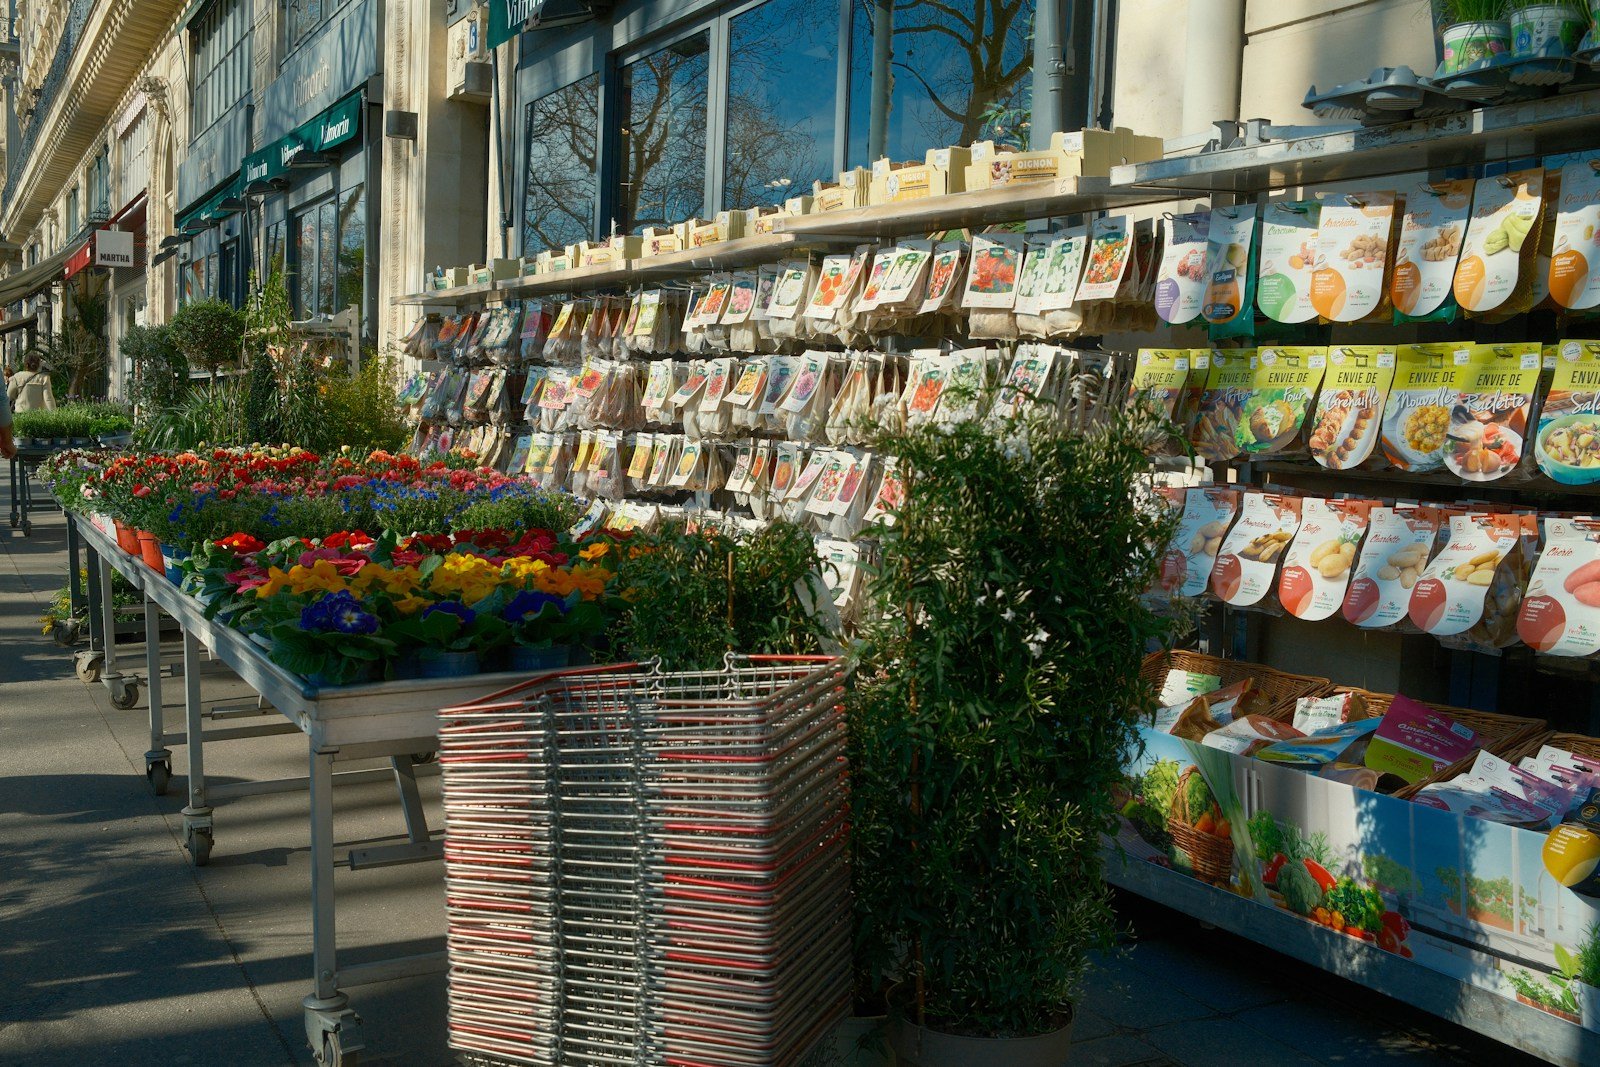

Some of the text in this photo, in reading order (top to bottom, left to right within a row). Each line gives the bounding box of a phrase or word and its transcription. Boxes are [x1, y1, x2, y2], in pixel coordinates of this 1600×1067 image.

[321, 115, 350, 145] Vilmorin
[1017, 159, 1053, 169] OIGNON
[100, 253, 130, 263] MARTHA
[1165, 373, 1176, 383] DE
[1218, 373, 1251, 384] ENVIE DE
[1268, 372, 1309, 383] ENVIE DE
[1337, 372, 1378, 384] ENVIE DE
[1409, 372, 1456, 384] ENVIE DE
[1476, 373, 1522, 386] ENVIE DE
[1397, 386, 1458, 408] Nouvelles
[1463, 388, 1526, 414] Raclette
[1397, 723, 1455, 746] amandine
